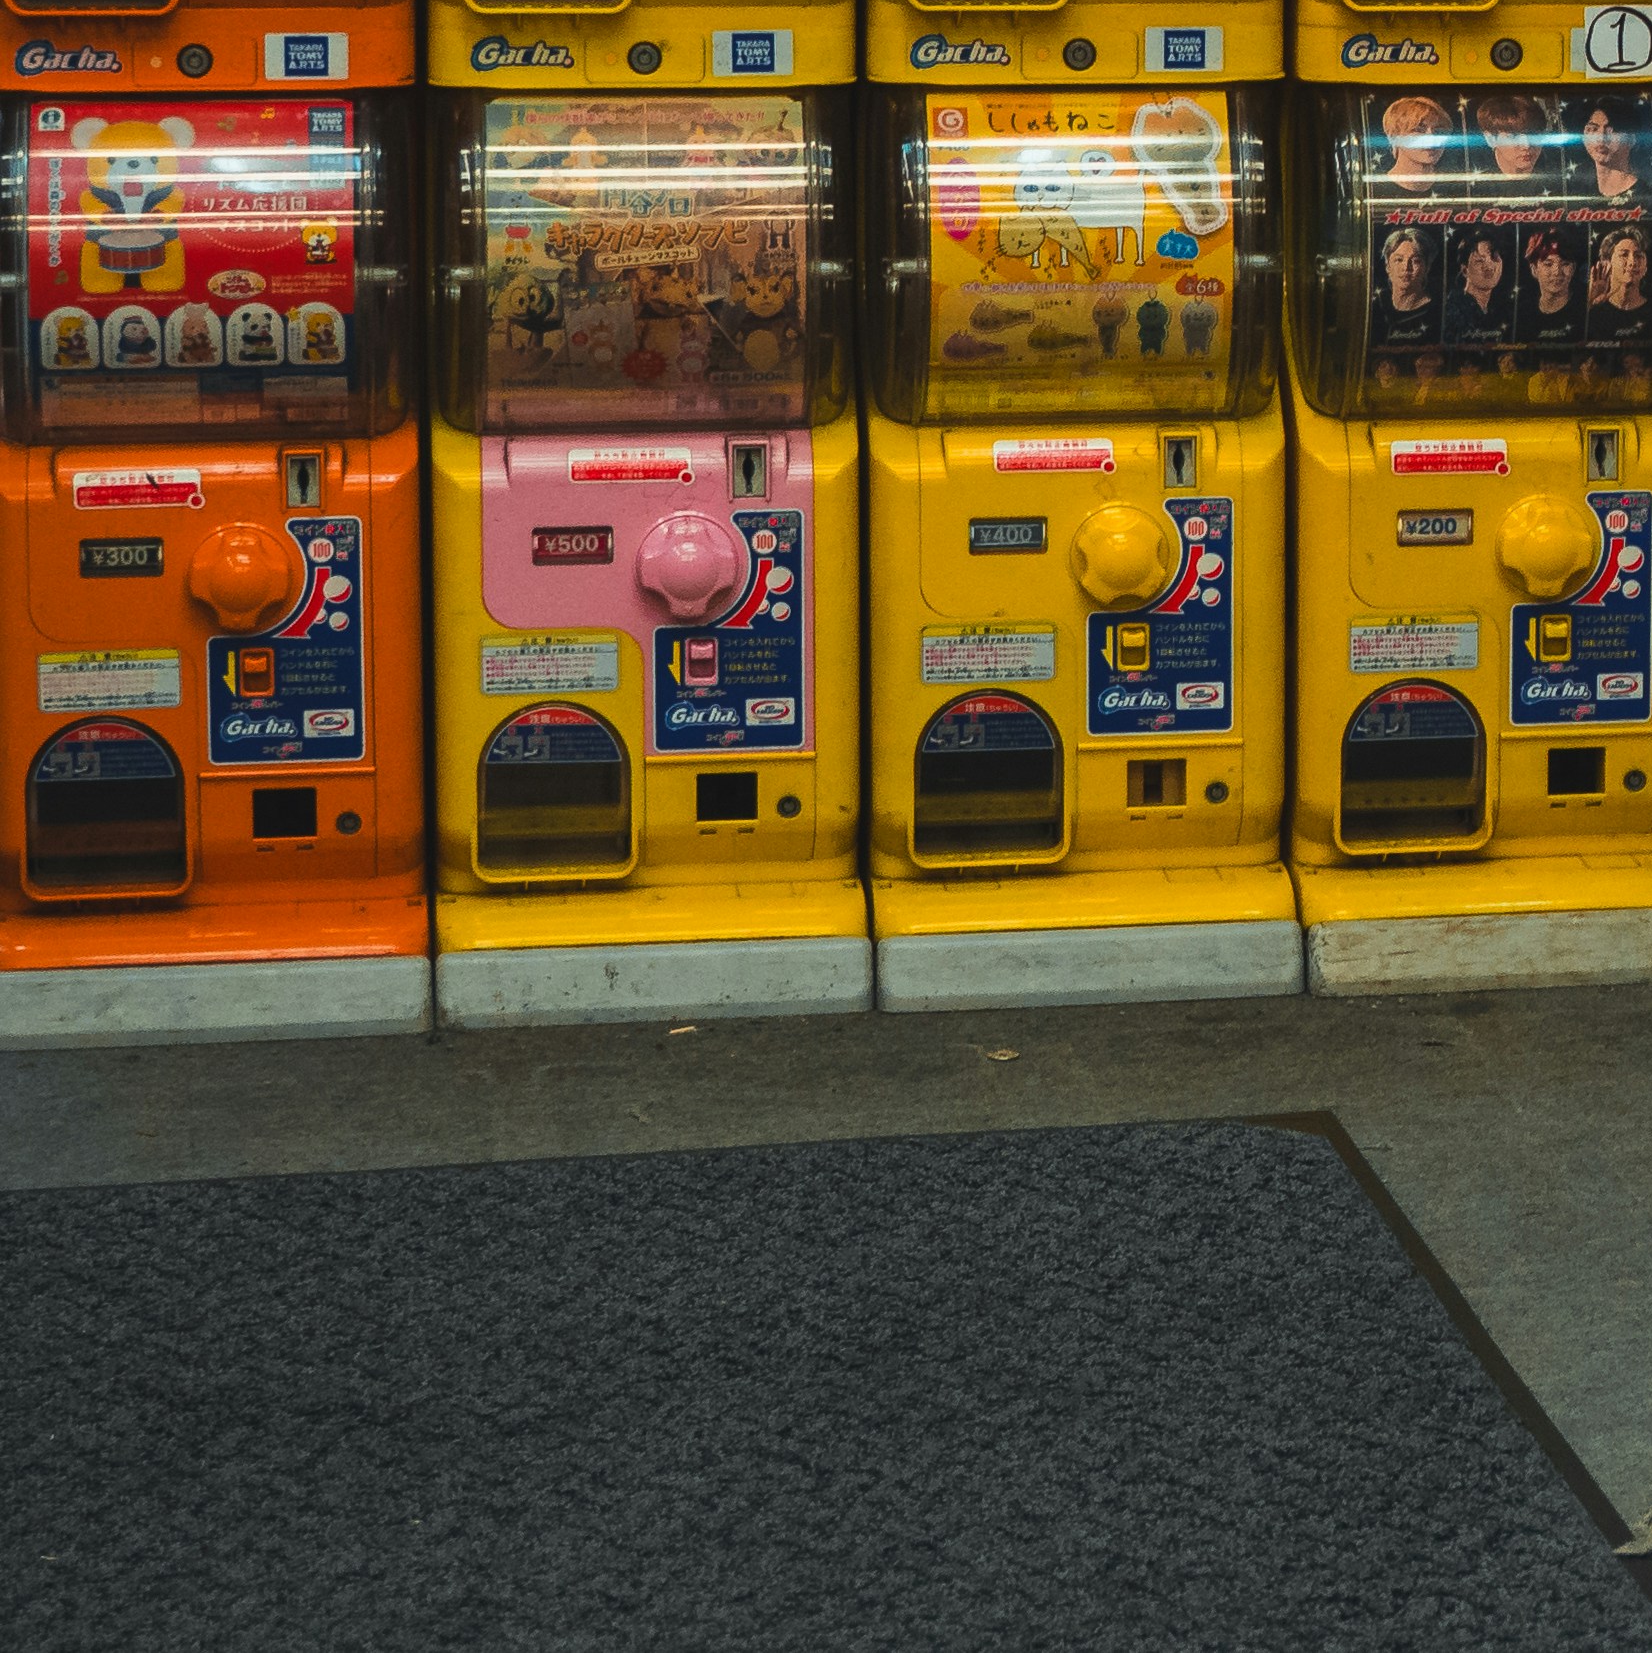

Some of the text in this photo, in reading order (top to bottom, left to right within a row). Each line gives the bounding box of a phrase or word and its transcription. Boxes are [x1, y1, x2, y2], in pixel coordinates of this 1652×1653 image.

[16, 43, 123, 77] Gacha.
[912, 38, 1009, 71] Gacha.
[203, 197, 307, 212] リズム応援団
[1454, 208, 1479, 223] of
[1482, 208, 1561, 224] Special
[1402, 516, 1459, 537] ¥200
[543, 535, 600, 554] ¥500
[91, 547, 149, 566] ¥300
[1098, 686, 1171, 714] Gacha.
[221, 716, 298, 743] Gacha.
